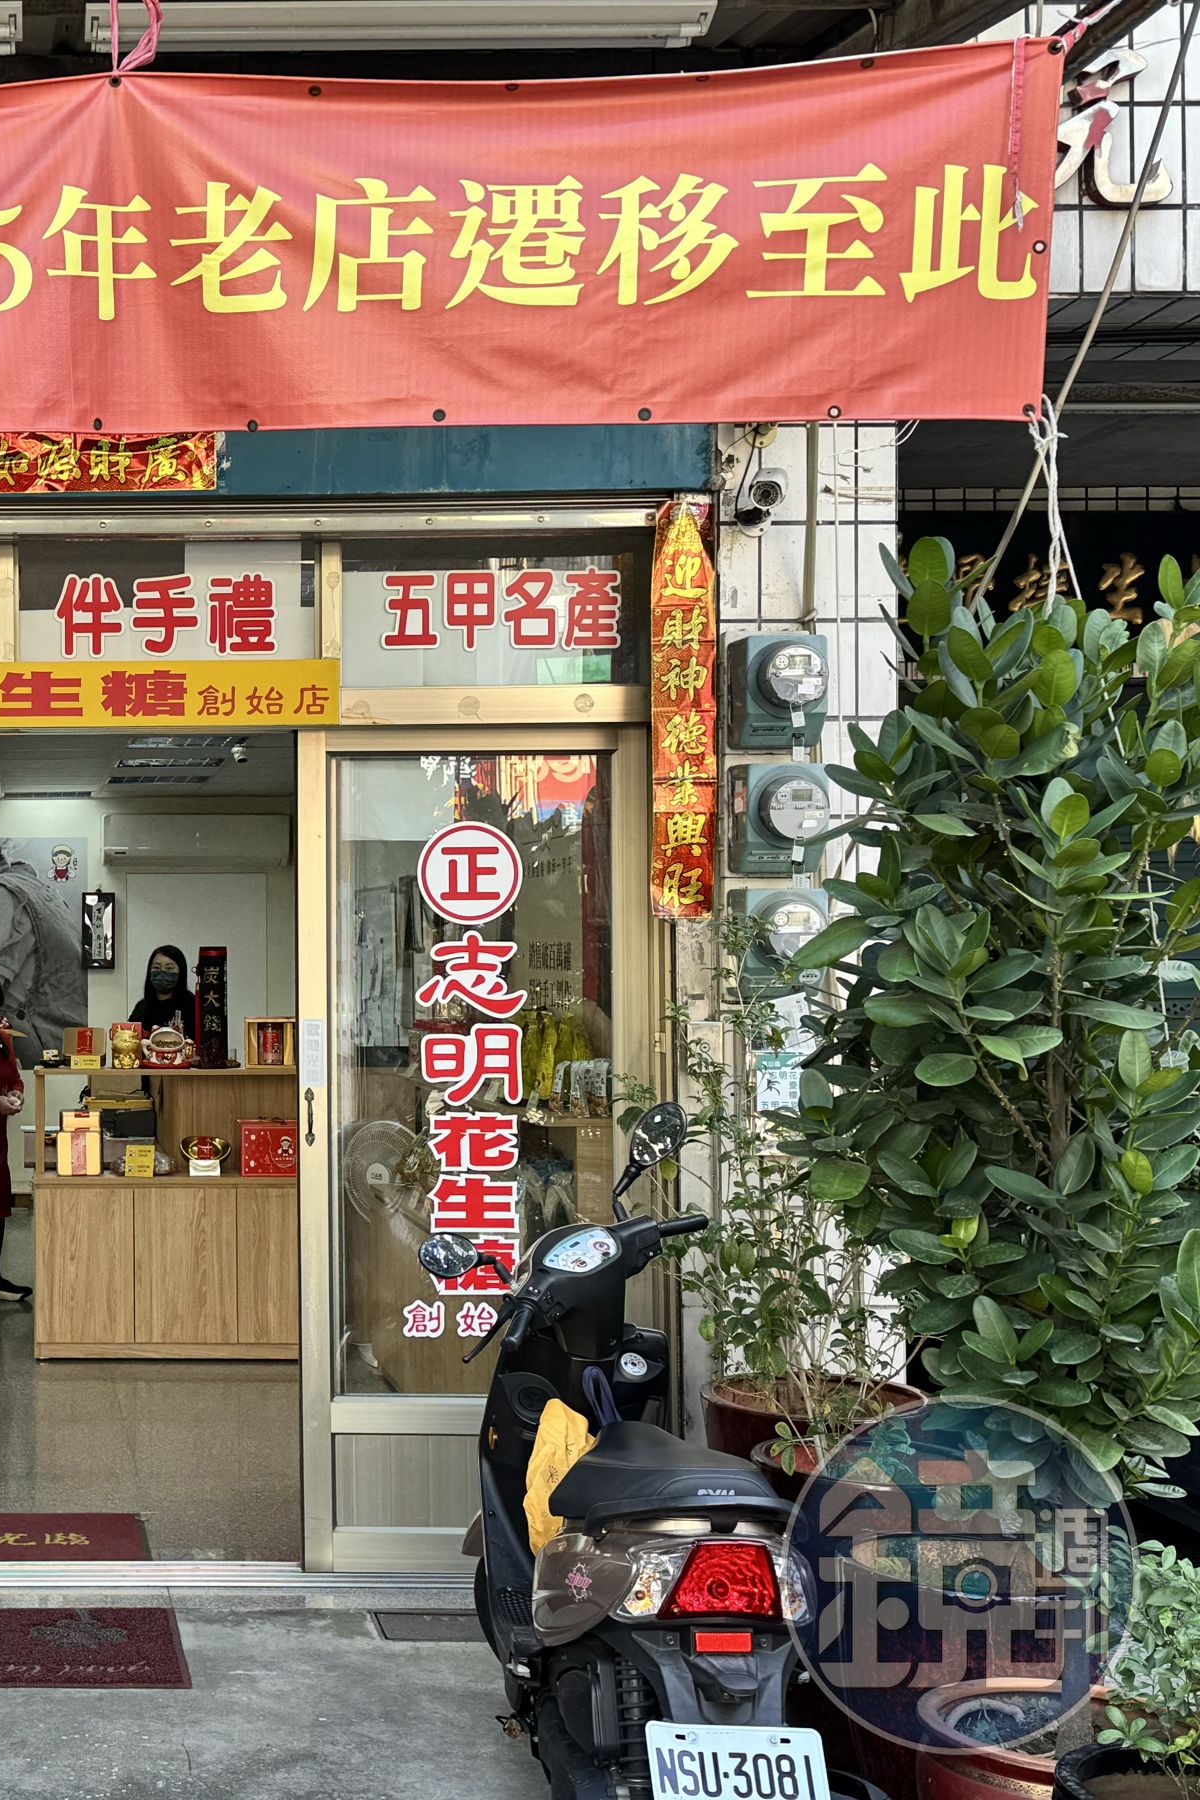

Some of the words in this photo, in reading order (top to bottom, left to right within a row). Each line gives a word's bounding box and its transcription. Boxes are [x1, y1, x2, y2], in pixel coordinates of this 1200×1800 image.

[54, 572, 279, 659] 伴手禮
[381, 566, 622, 651] 五甲名產
[197, 684, 331, 717] 創始店
[657, 554, 710, 909] 迎財神德業興旺
[416, 932, 526, 1294] 志明花生糖
[655, 1747, 816, 1800] NSU-3081
